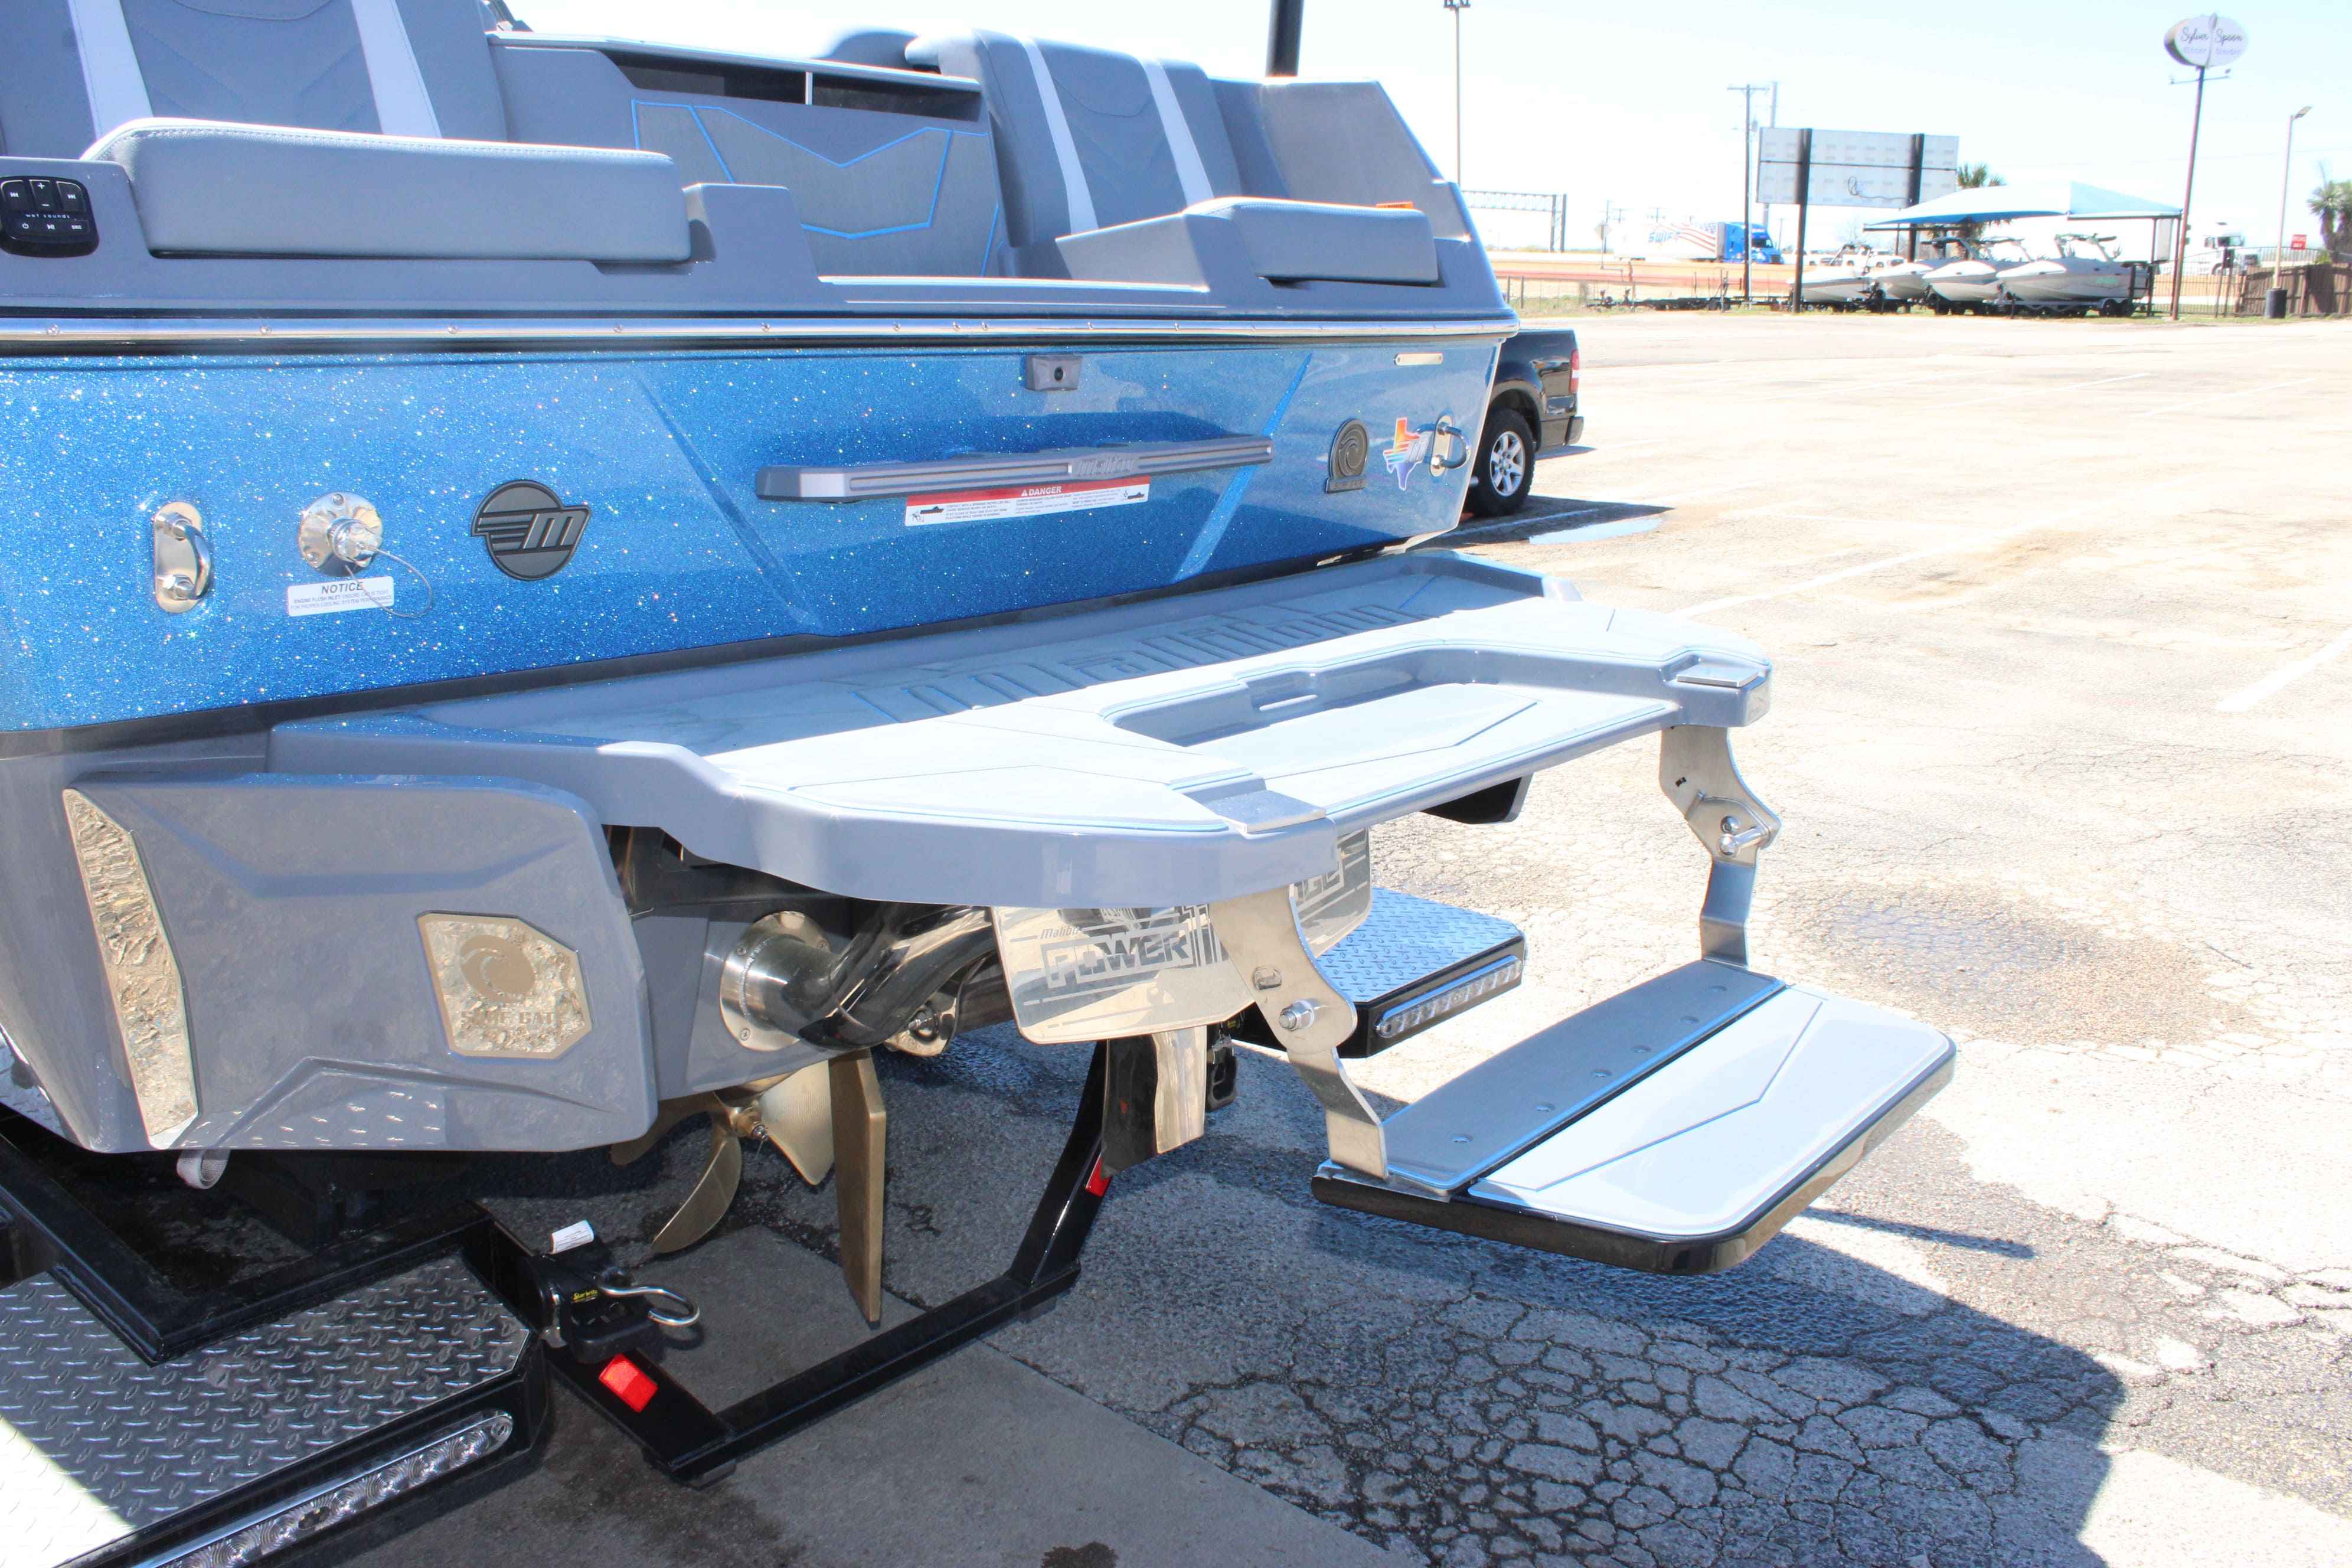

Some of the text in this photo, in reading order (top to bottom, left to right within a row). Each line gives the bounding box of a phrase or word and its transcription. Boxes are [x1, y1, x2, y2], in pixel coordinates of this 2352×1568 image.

[1028, 486, 1062, 496] DANGER
[321, 581, 364, 594] NOTICE
[1040, 926, 1078, 939] Malibu
[1045, 932, 1191, 982] POWER
